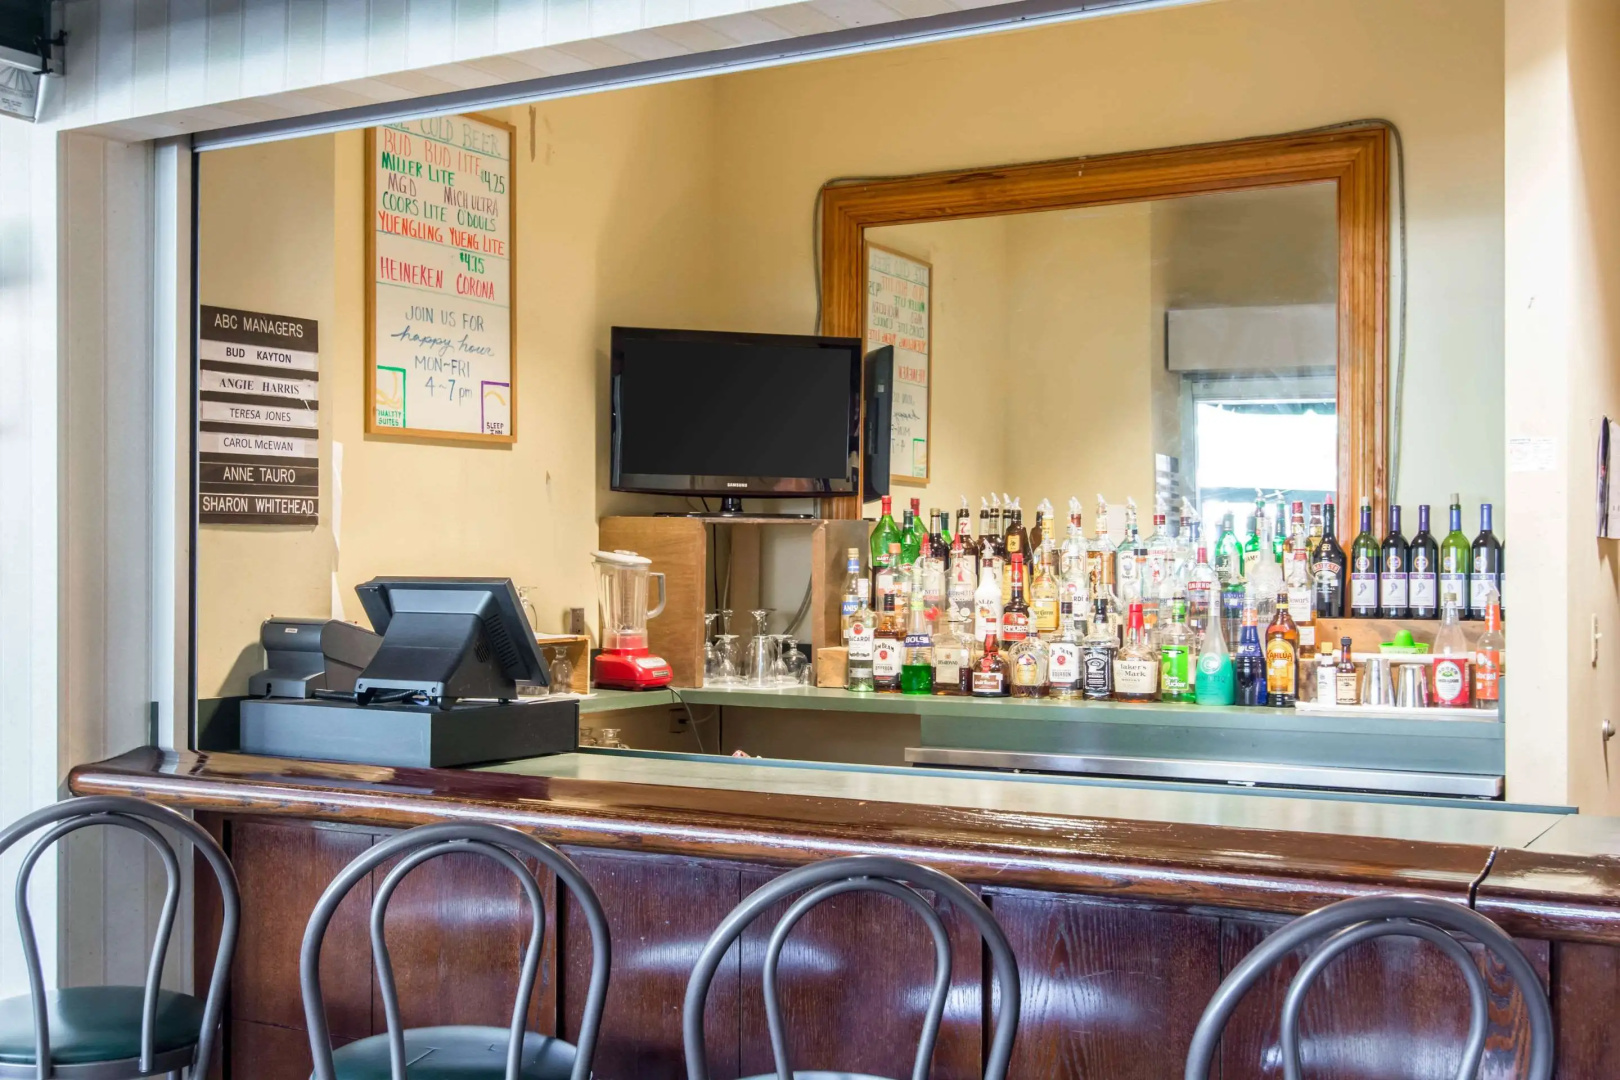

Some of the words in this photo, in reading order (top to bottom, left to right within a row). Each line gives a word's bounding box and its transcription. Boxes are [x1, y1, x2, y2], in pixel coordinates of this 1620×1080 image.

[420, 117, 454, 143] COLD
[463, 123, 501, 156] BEER
[384, 128, 412, 157] BUD
[424, 140, 451, 168] BUD
[458, 151, 482, 177] LITE
[381, 151, 423, 179] MILLER
[428, 164, 455, 187] LITE
[388, 172, 417, 197] MGD
[382, 191, 419, 216] COORS
[424, 201, 447, 222] LITE
[444, 186, 468, 210] MICH
[471, 194, 499, 217] ULTRA
[378, 211, 444, 244] YUENGLING
[449, 226, 479, 251] YUENG
[483, 234, 505, 256] LITE
[380, 256, 444, 289] HEINEKEN
[456, 273, 495, 301] CORONA
[214, 313, 238, 330] ABC
[243, 317, 304, 338] MANAGERS
[405, 305, 434, 324] JOIN
[441, 309, 456, 328] US
[463, 313, 485, 332] FOR
[391, 325, 455, 357] happy
[457, 334, 496, 357] hour
[226, 346, 246, 358] BUD
[256, 350, 292, 364] KAYTON
[219, 378, 254, 391] ANGIE
[262, 382, 300, 395] HARRIS
[458, 387, 473, 406] pm
[229, 408, 261, 420] TERESA
[265, 411, 291, 422] JONES
[486, 421, 504, 430] SLEEP
[223, 437, 252, 449] CAROL
[254, 439, 294, 452] McEWAN
[223, 466, 254, 482] ANNE
[259, 467, 296, 483] TAURO
[202, 496, 248, 513] SHARON
[255, 498, 315, 514] WHITEHEAD
[881, 642, 895, 653] BEAM
